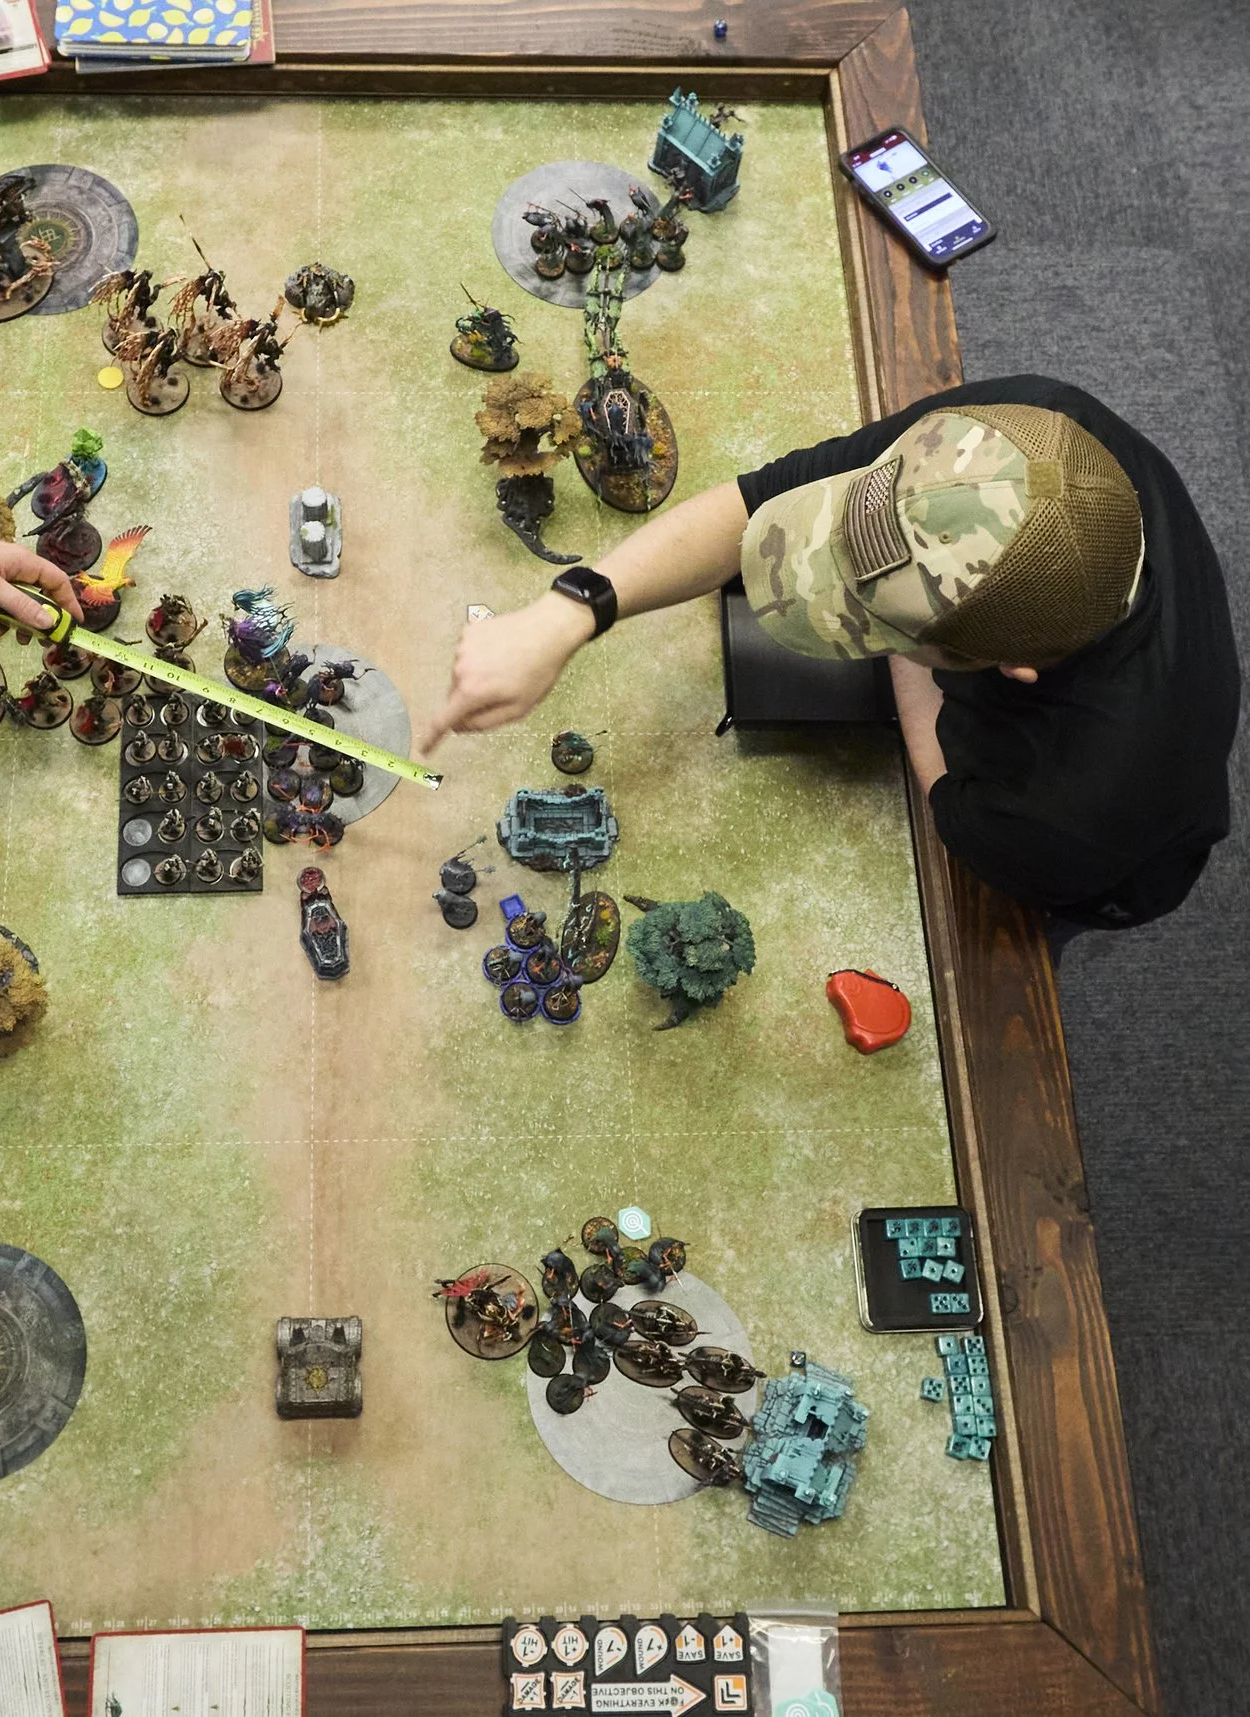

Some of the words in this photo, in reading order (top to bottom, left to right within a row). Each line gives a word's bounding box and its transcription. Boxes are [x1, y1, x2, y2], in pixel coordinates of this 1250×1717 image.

[521, 1636, 538, 1646] HIT
[562, 1636, 578, 1645] HIT
[637, 1638, 646, 1670] WOUND
[678, 1650, 703, 1659] SAVE
[716, 1650, 741, 1659] SAVE
[516, 1678, 541, 1705] DAMAGE
[557, 1677, 581, 1704] DAMAGE
[592, 1687, 646, 1697] OBJECTIVE
[647, 1686, 669, 1695] THIS
[670, 1687, 684, 1695] ON
[596, 1698, 655, 1708] EVERYTHING
